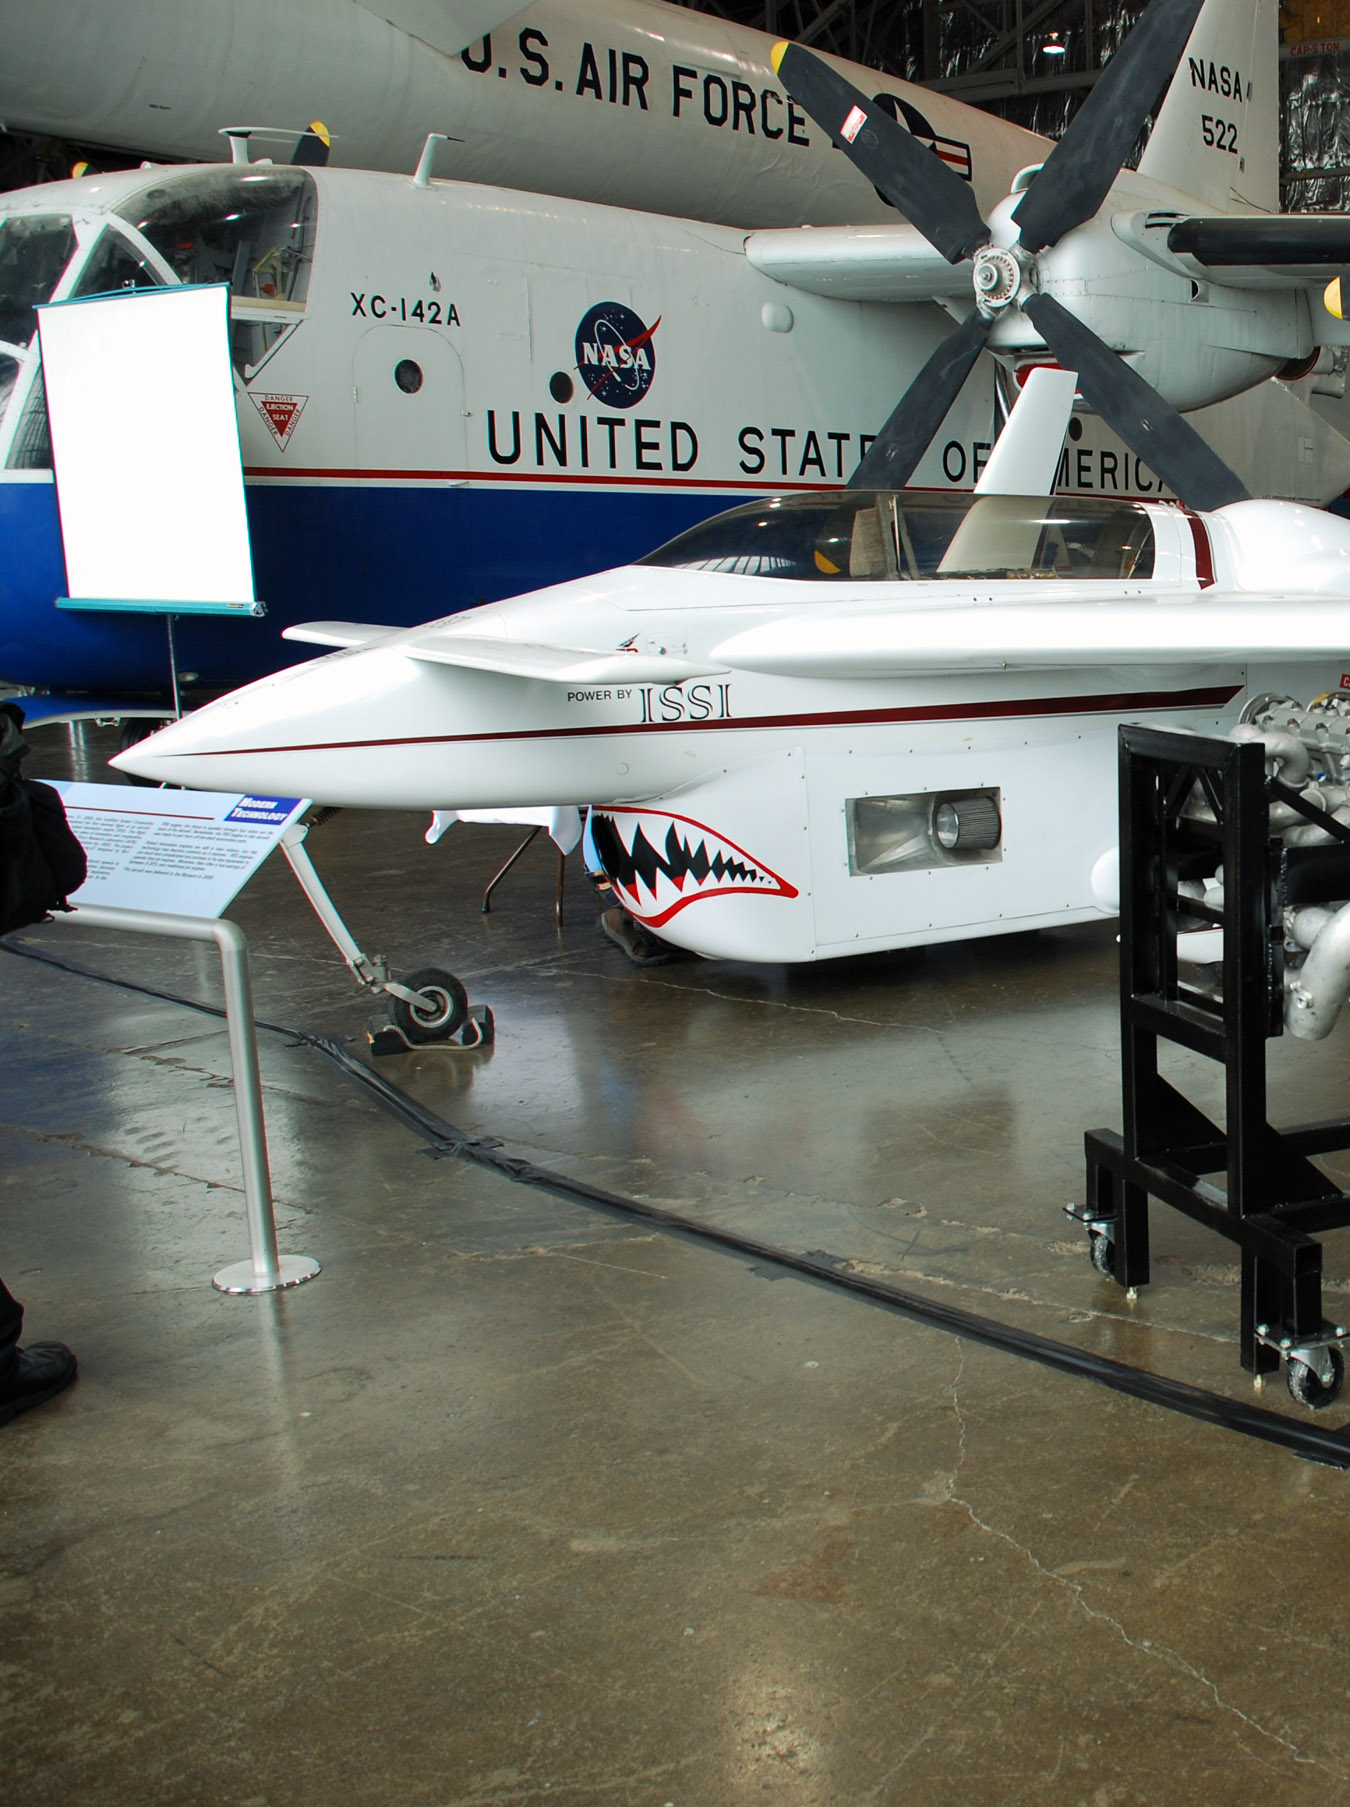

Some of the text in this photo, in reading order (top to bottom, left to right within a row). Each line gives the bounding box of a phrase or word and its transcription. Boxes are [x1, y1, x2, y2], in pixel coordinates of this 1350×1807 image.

[1321, 41, 1340, 53] TON
[575, 41, 649, 111] AIR
[672, 64, 810, 147] FORCE
[1188, 57, 1243, 103] NASA
[1201, 114, 1239, 155] 522
[350, 292, 461, 327] XC-142A
[582, 342, 652, 371] NASA
[266, 403, 294, 411] EJECTION
[487, 410, 699, 472] UNITED
[737, 426, 880, 479] STAT
[567, 684, 733, 723] POWER BY ISSI
